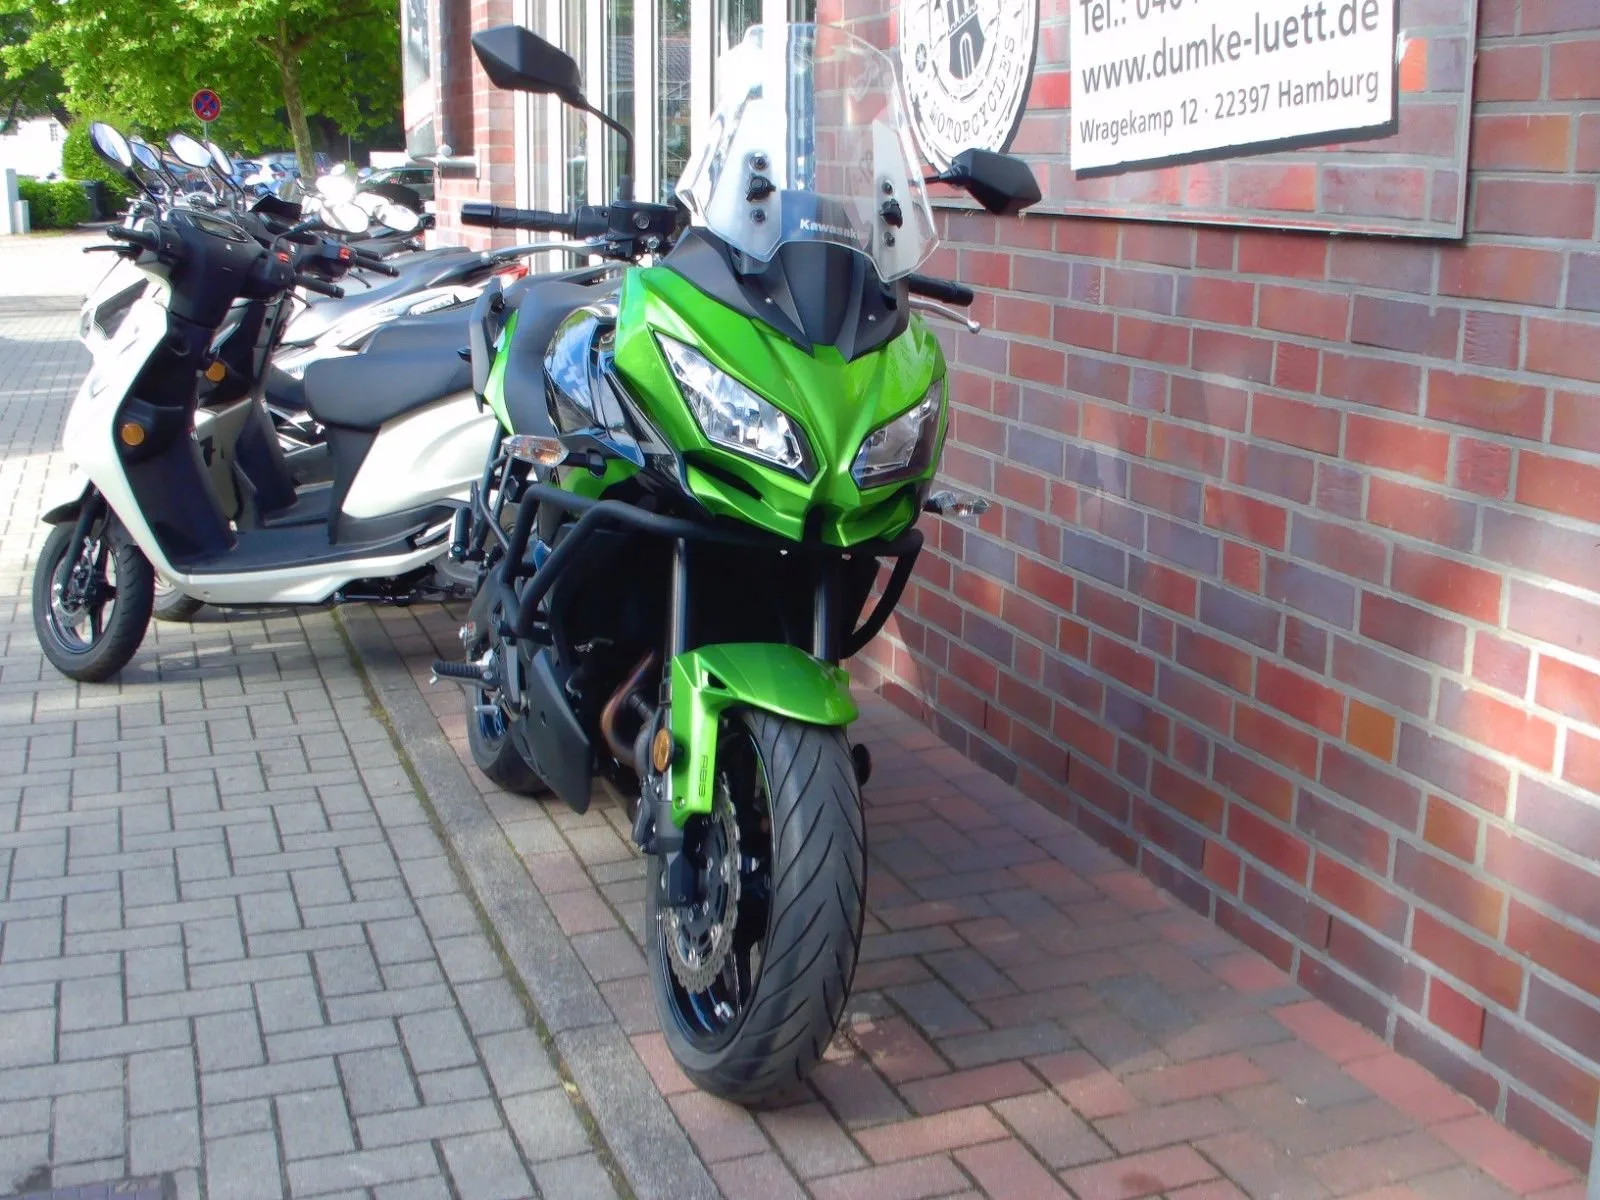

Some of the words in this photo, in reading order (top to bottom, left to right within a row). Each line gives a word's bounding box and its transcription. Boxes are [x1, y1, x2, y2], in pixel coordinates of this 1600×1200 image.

[927, 34, 1016, 144] MOTORCYCLES
[1082, 0, 1380, 94] www.dumke-luett.de
[1079, 110, 1173, 146] Wragekamp
[1180, 98, 1199, 126] 12
[1214, 84, 1271, 120] 22397
[1278, 69, 1380, 109] Hamburg
